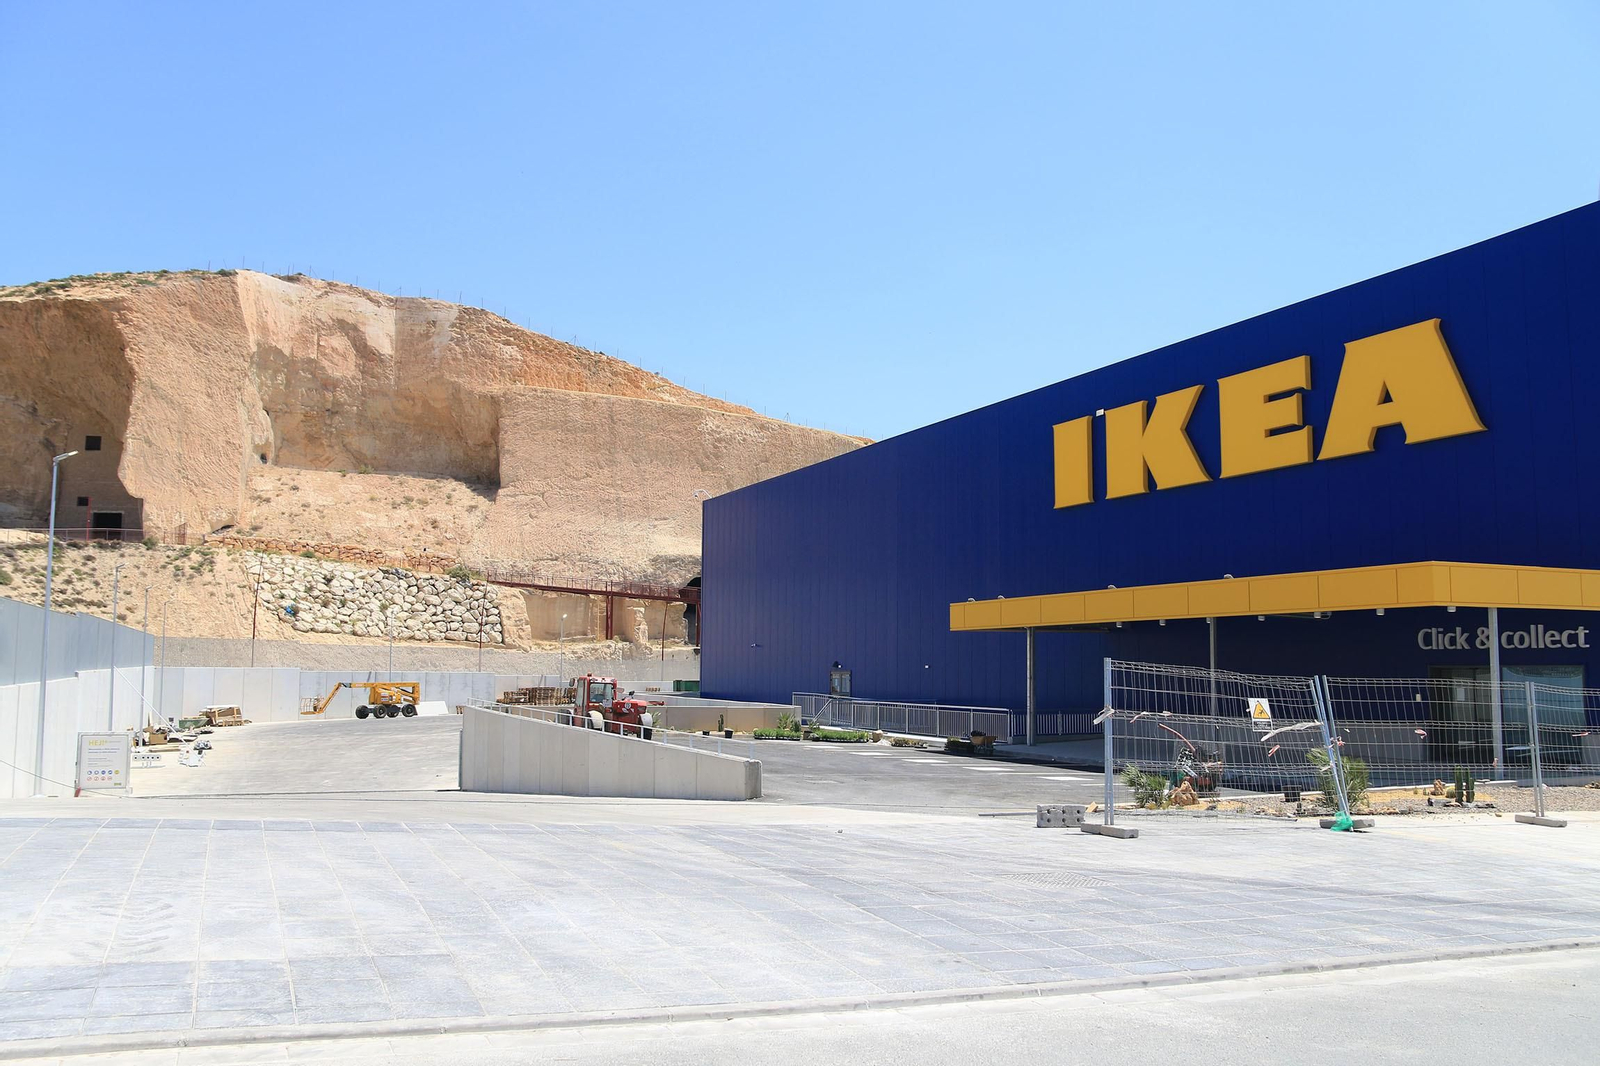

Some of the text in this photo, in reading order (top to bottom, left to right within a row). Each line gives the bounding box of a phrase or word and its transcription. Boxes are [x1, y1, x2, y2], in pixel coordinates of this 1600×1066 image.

[1052, 317, 1488, 509] IKEA
[1417, 624, 1590, 650] Click & collect
